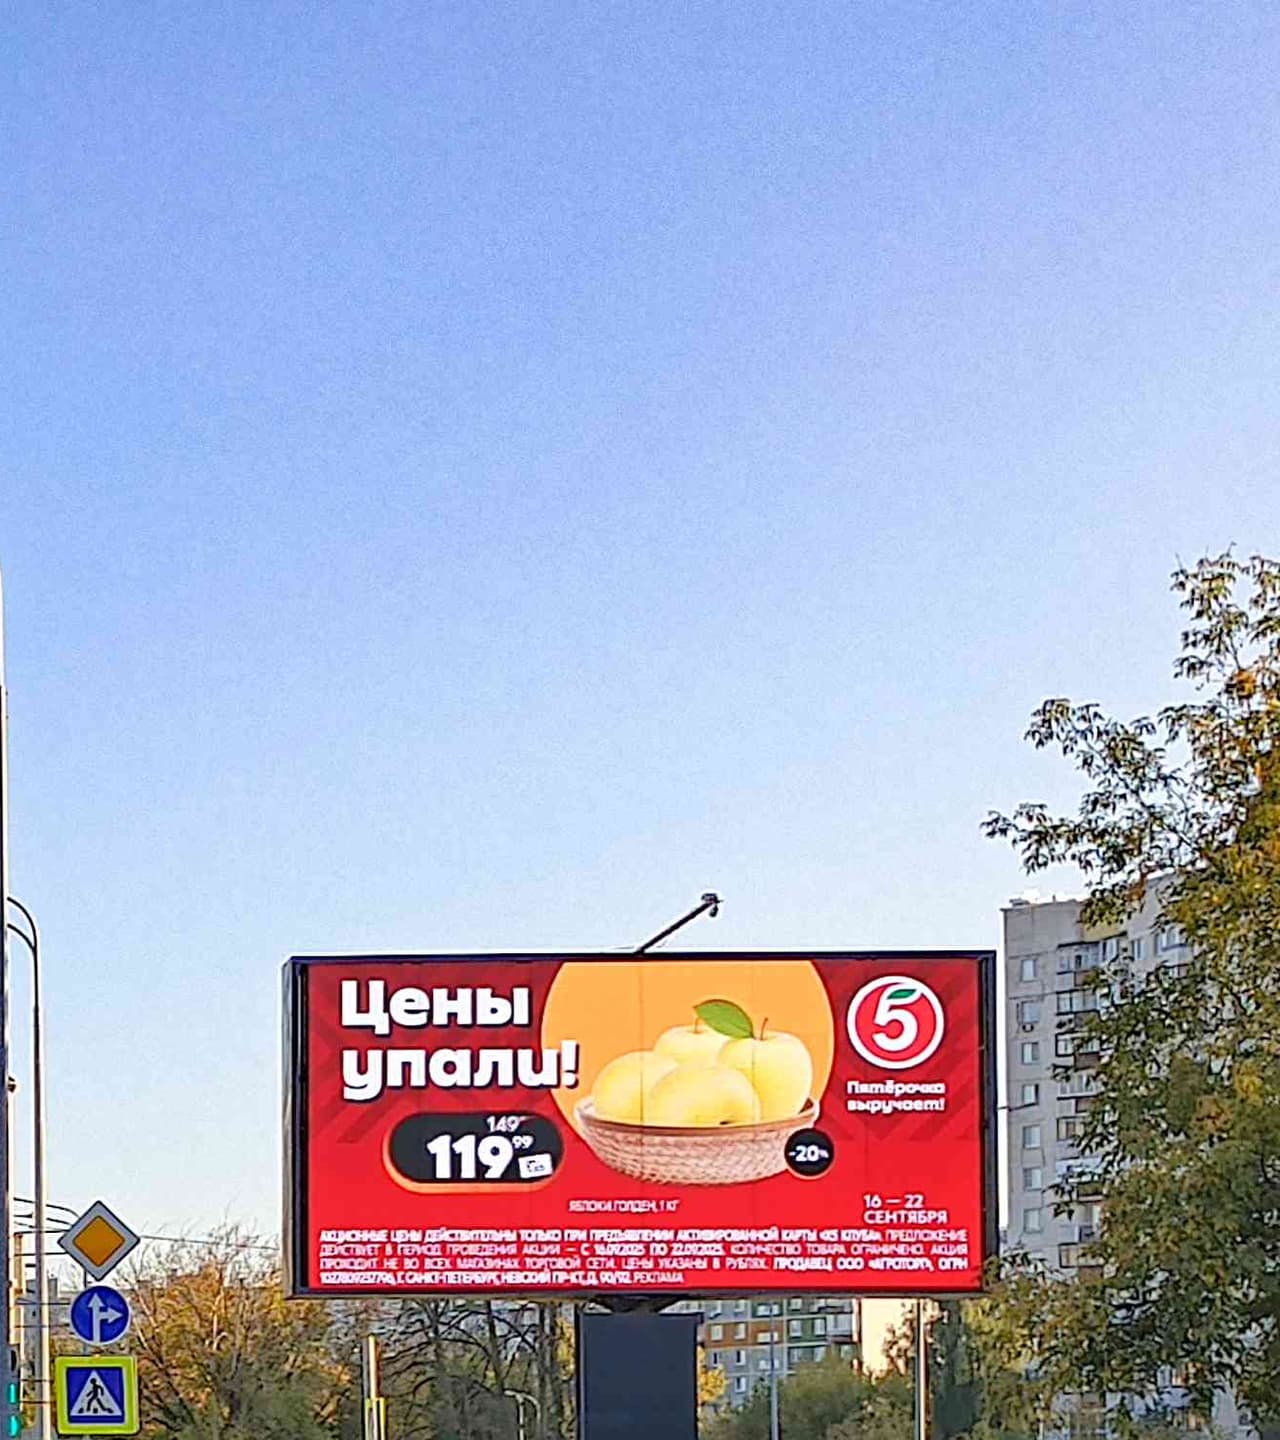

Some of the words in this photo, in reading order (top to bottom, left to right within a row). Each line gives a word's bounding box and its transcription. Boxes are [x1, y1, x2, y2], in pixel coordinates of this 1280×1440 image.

[341, 980, 530, 1035] Цены
[343, 1040, 578, 1101] упали!
[847, 1079, 946, 1096] Пятёрочка
[847, 1097, 946, 1113] выручает!
[427, 1134, 514, 1179] 119
[864, 1194, 882, 1208] 16
[904, 1194, 924, 1208] 22
[863, 1210, 948, 1225] СЕНТЯБРЯ
